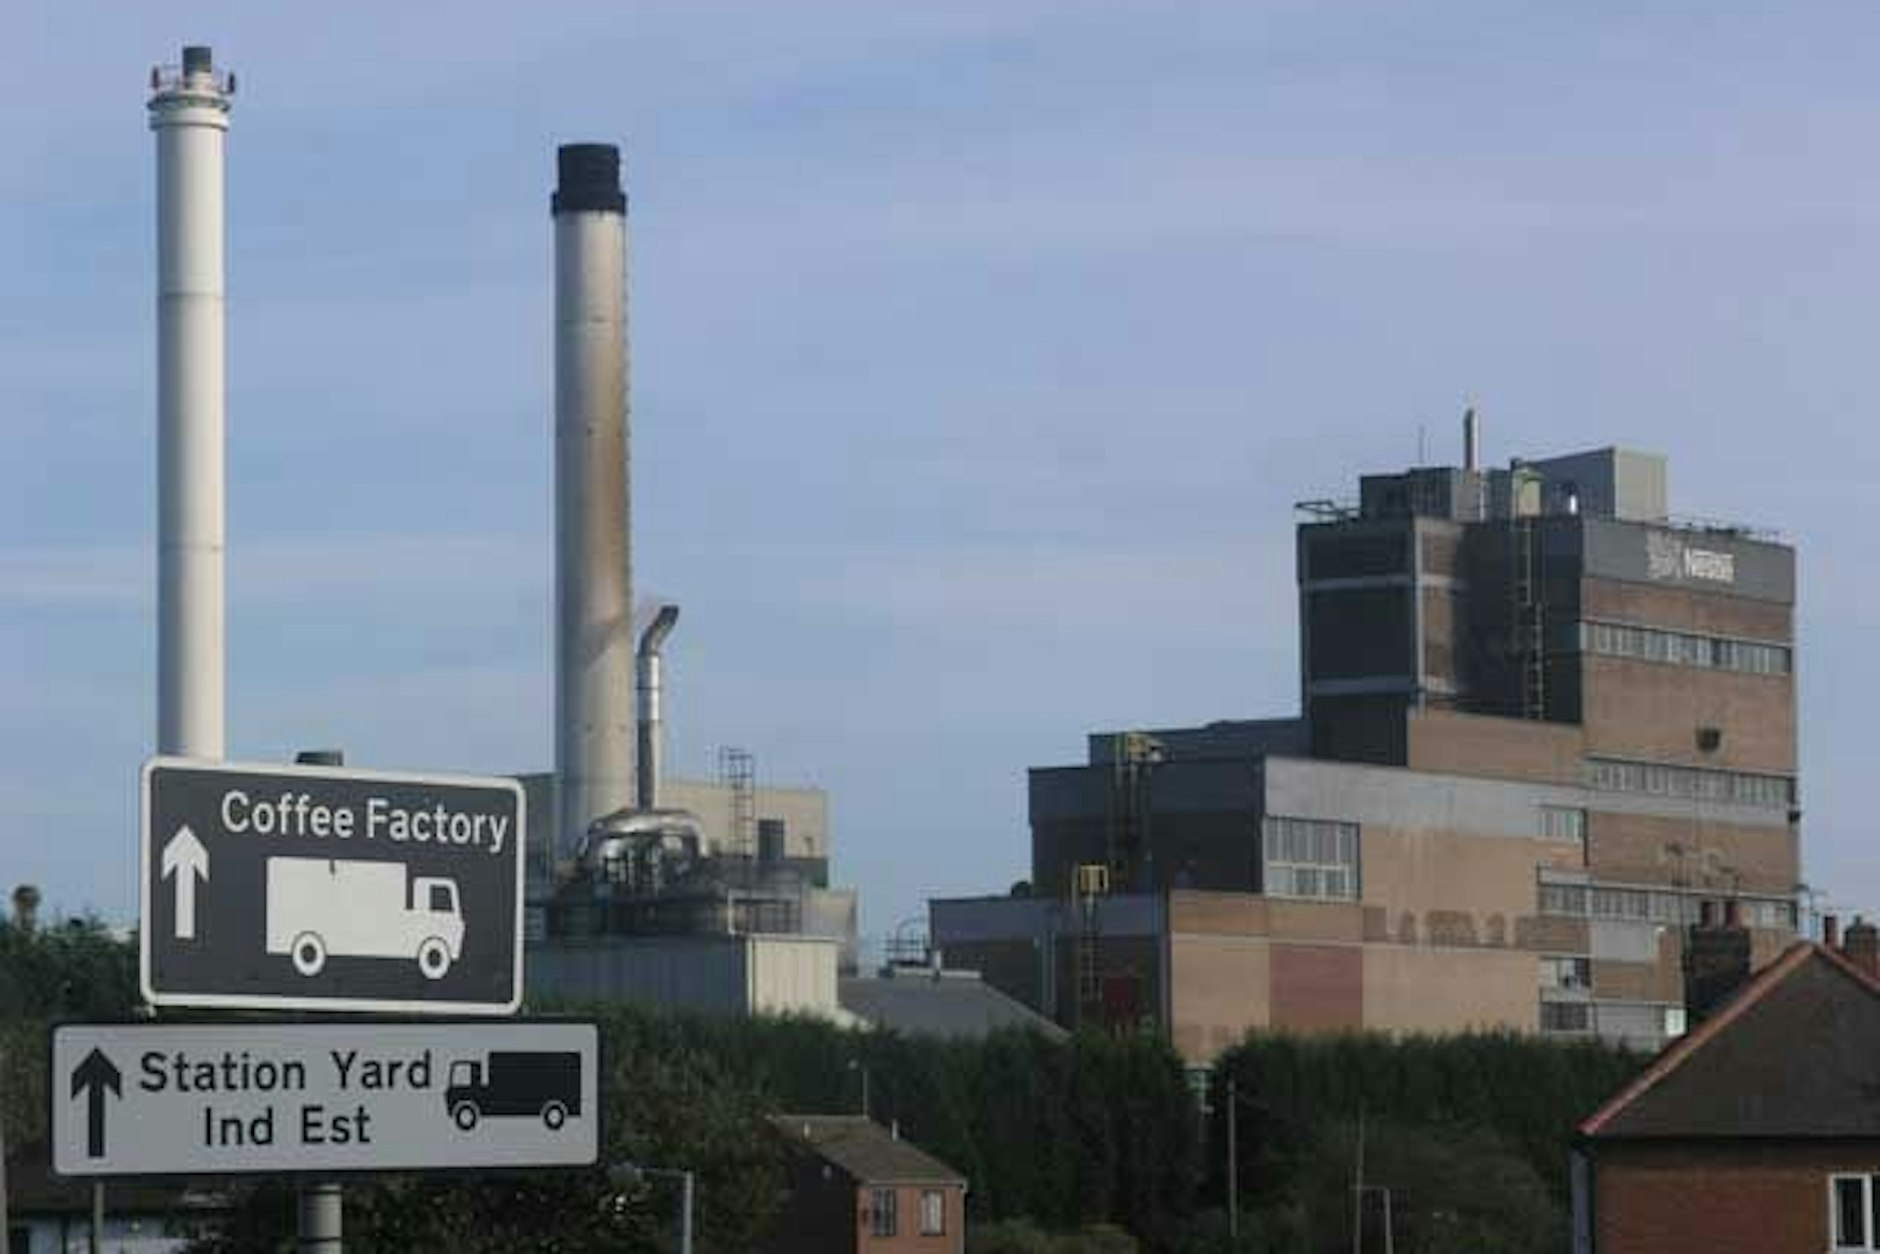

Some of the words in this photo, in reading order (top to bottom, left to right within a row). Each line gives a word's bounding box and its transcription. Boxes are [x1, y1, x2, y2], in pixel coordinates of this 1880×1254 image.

[221, 790, 354, 838] Coffee
[366, 799, 508, 853] Factory
[139, 1050, 305, 1092] Station
[330, 1050, 432, 1091] Yard
[204, 1107, 273, 1146] Ind
[302, 1105, 371, 1145] Est
